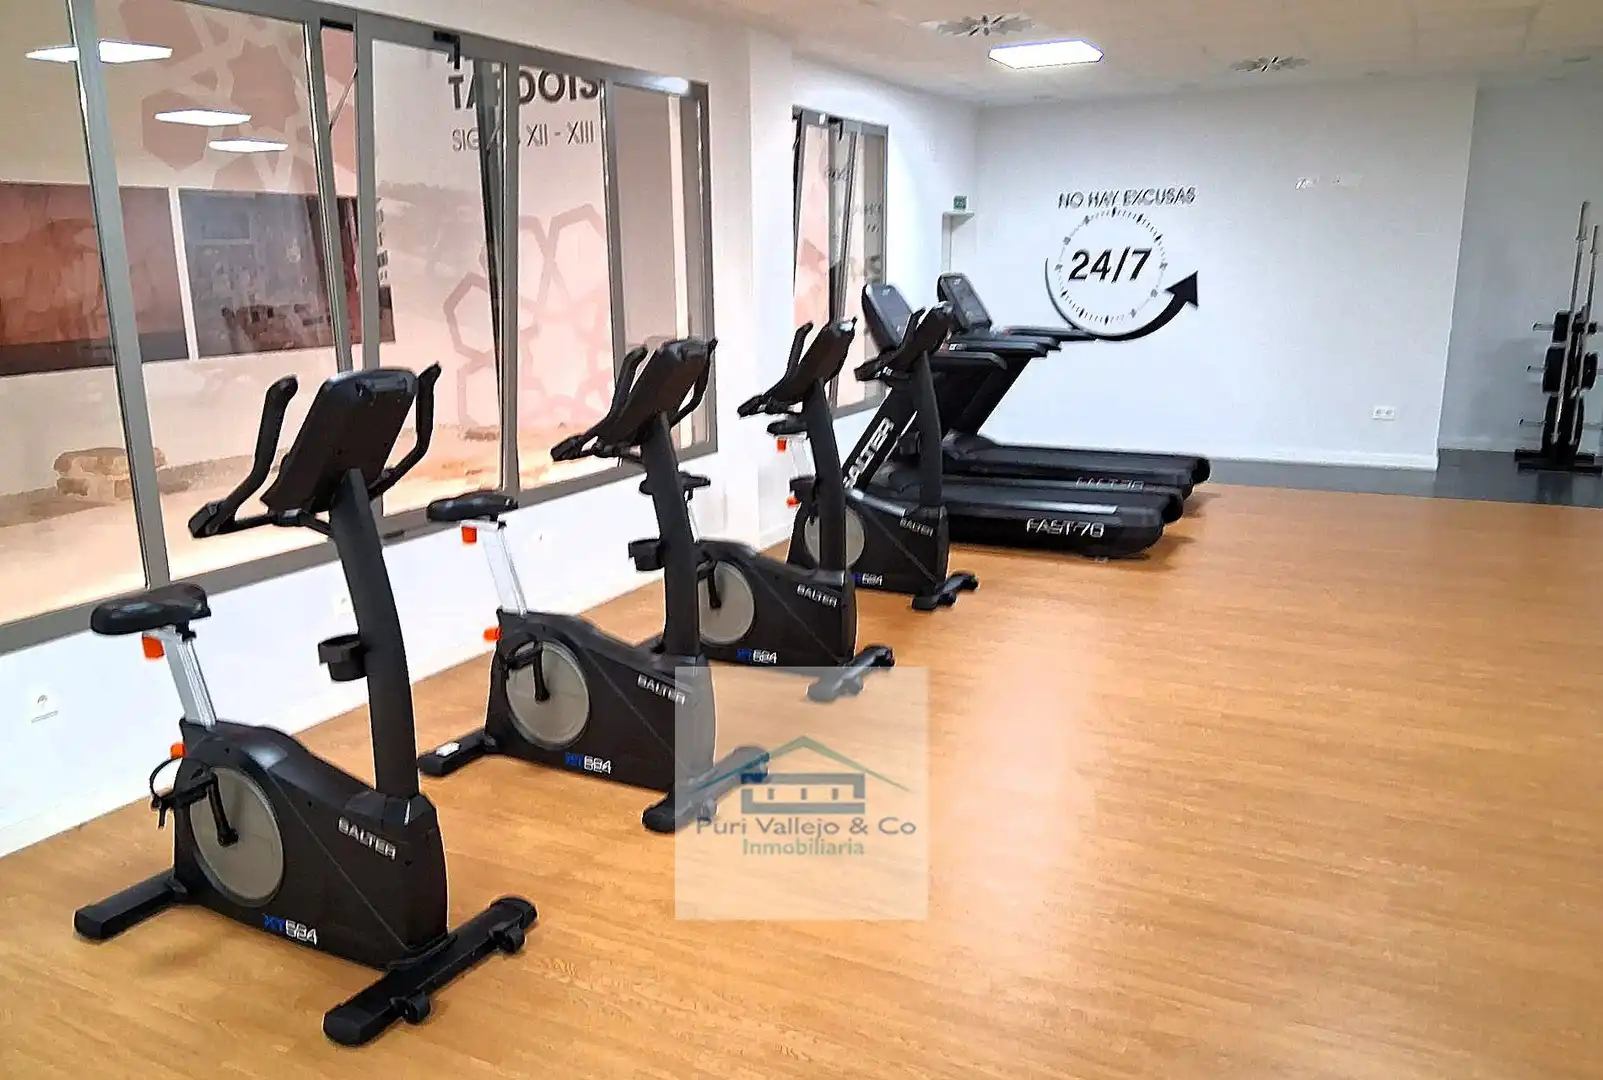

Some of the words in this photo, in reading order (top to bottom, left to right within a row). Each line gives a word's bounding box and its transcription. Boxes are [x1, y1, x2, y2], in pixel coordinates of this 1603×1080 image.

[526, 123, 548, 147] XII
[566, 120, 594, 145] XIII
[1058, 191, 1085, 209] NO
[1088, 189, 1119, 208] HAY
[1123, 186, 1196, 206] EXCUSAS
[1068, 246, 1152, 283] 24/7
[338, 816, 396, 860] SALTER
